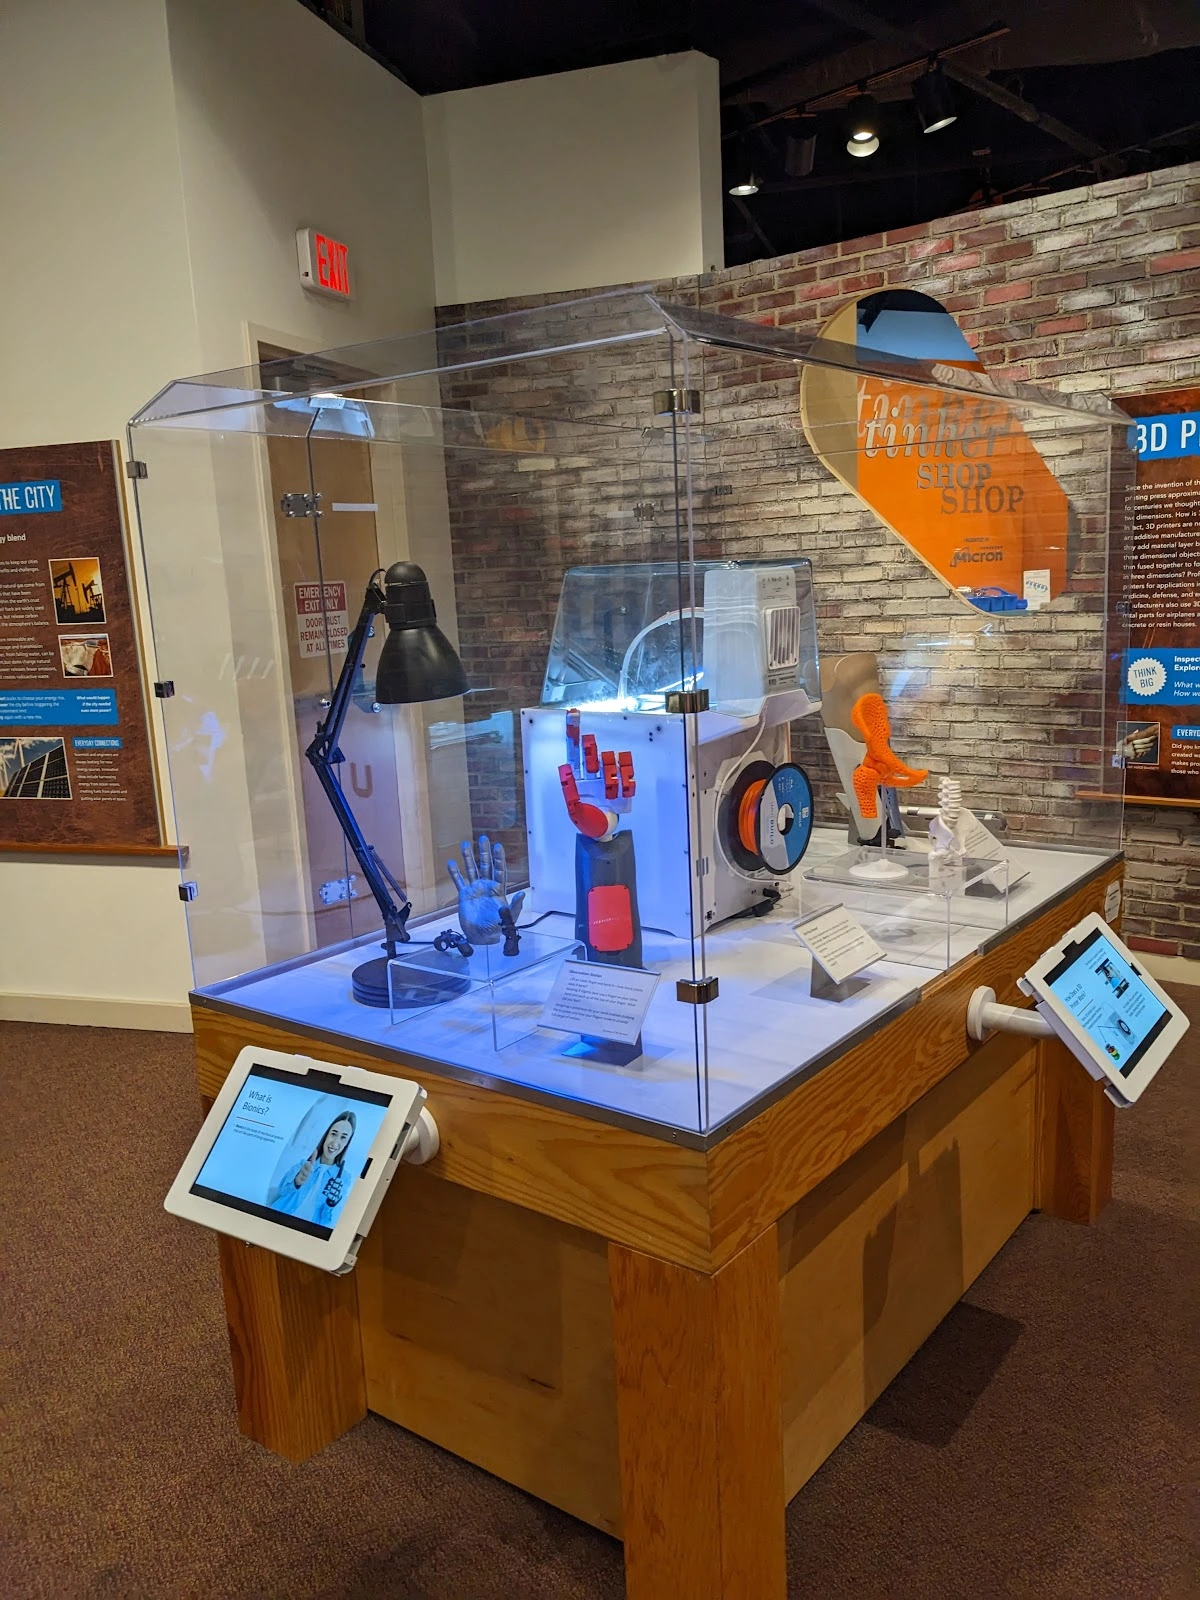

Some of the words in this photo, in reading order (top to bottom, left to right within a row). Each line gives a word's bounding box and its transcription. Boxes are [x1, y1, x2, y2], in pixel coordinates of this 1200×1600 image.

[316, 233, 349, 295] EXIT
[1137, 423, 1167, 453] 3D
[1181, 419, 1200, 448] P
[917, 463, 992, 489] SHOP
[1155, 481, 1184, 489] invention
[24, 485, 54, 508] CITY
[941, 485, 1024, 515] SHOP
[1134, 503, 1162, 511] centuries
[1136, 512, 1173, 520] dimensions.
[7, 532, 26, 542] blend
[1151, 542, 1177, 550] material
[950, 547, 1003, 567] Micron
[299, 586, 341, 598] EMERENCY
[305, 600, 320, 611] EXIT
[325, 598, 339, 610] NLY
[306, 618, 324, 628] DOOR
[300, 631, 325, 641] REMAIN
[307, 643, 313, 653] AT
[316, 642, 326, 652] ALL
[1133, 666, 1157, 678] THINK
[1140, 678, 1154, 688] BIG
[1174, 681, 1193, 689] What
[248, 1090, 266, 1102] What
[266, 1094, 272, 1103] is
[242, 1101, 270, 1116] Bionics?
